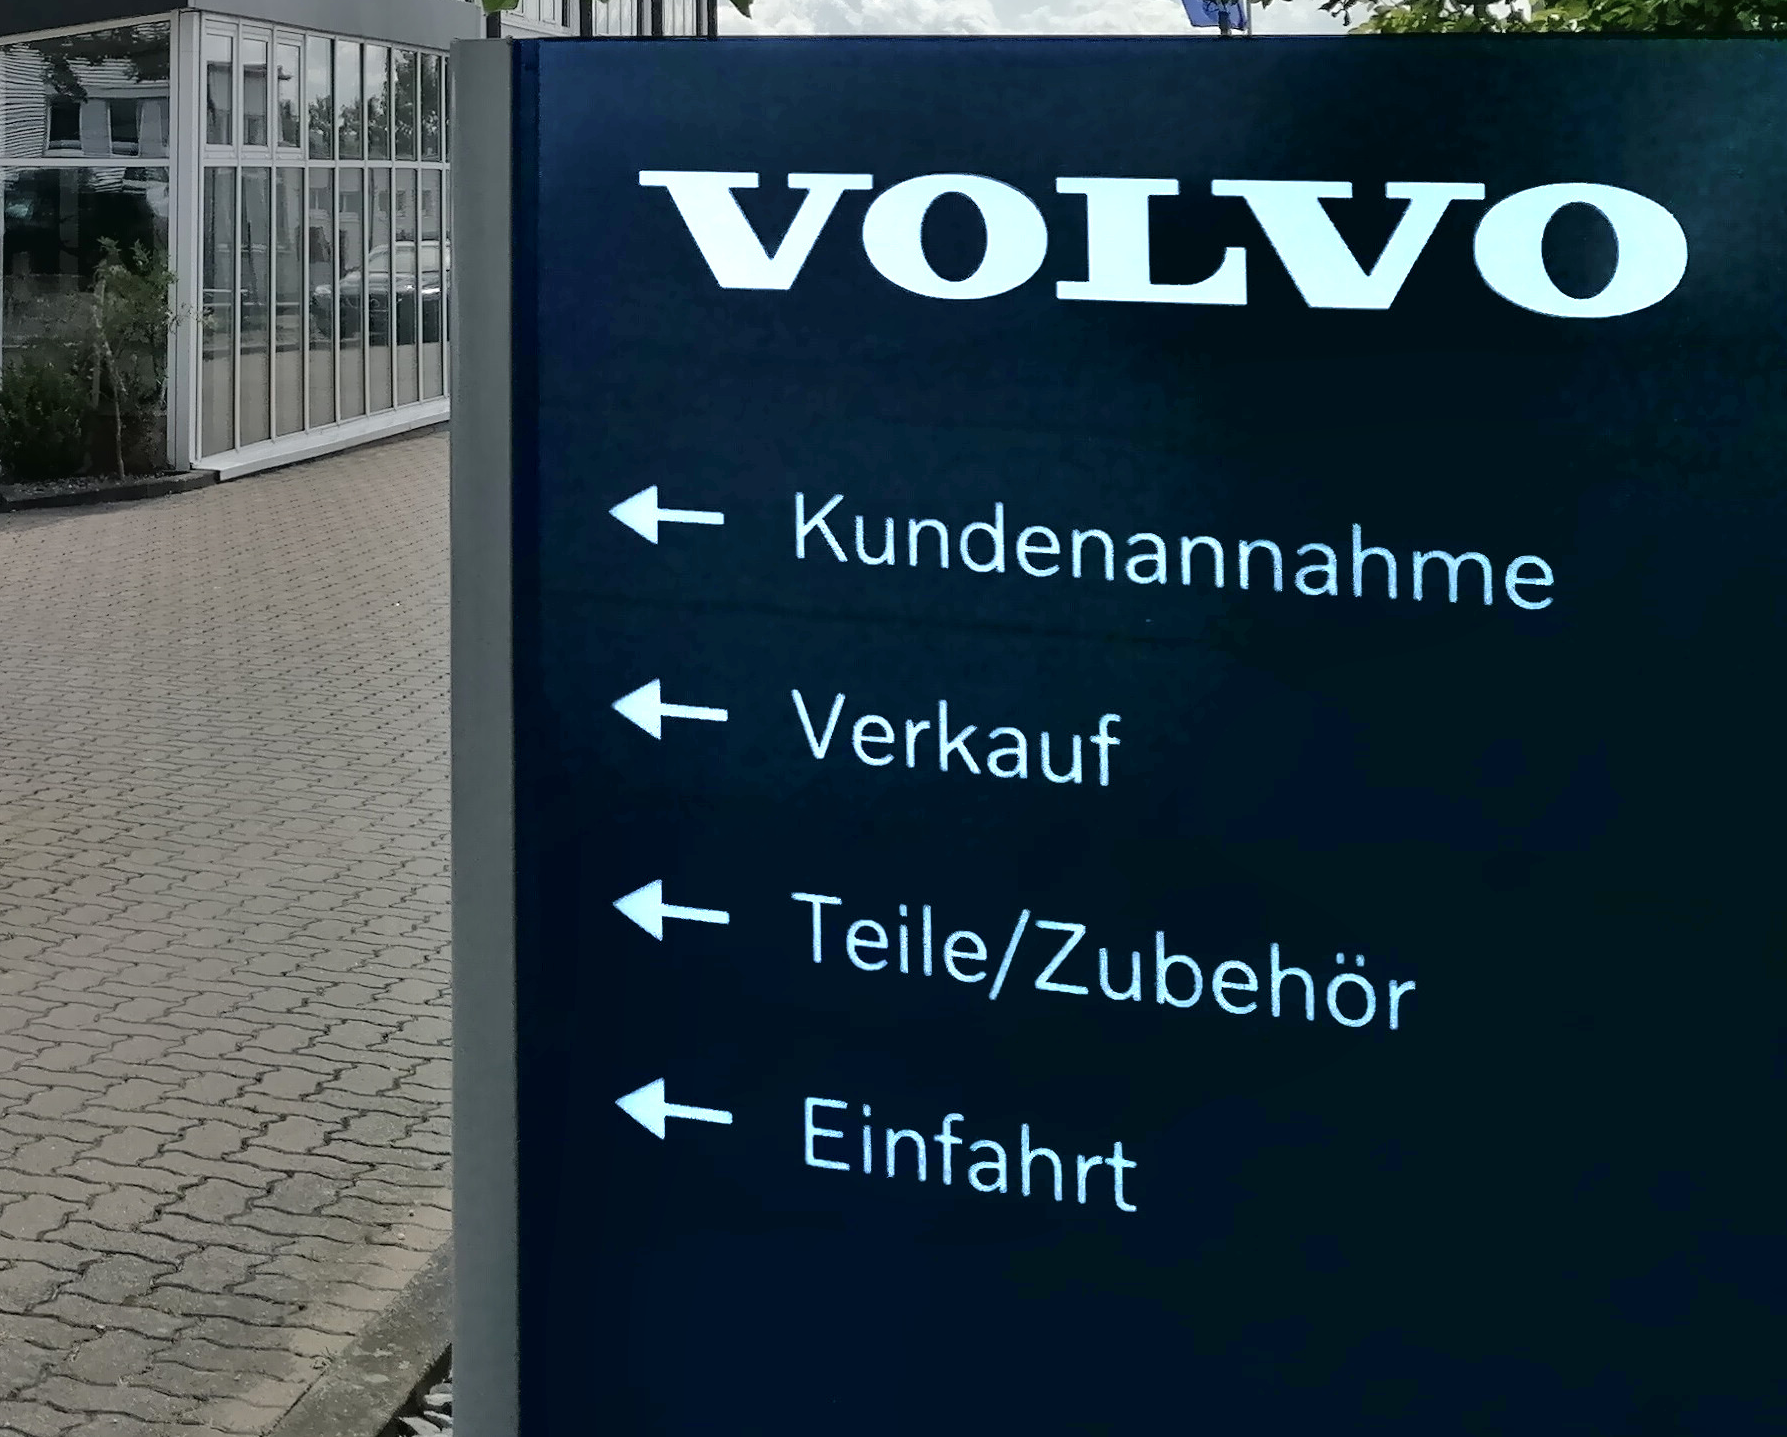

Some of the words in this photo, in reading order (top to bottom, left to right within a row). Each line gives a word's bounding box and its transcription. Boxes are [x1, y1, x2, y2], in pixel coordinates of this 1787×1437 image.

[638, 170, 1689, 319] VOLVO
[794, 491, 1555, 610] Kundenannahme
[791, 688, 1121, 787] Verkauf
[791, 892, 1416, 1030] Teile/Zubehör
[804, 1096, 1138, 1212] Einfahrt
